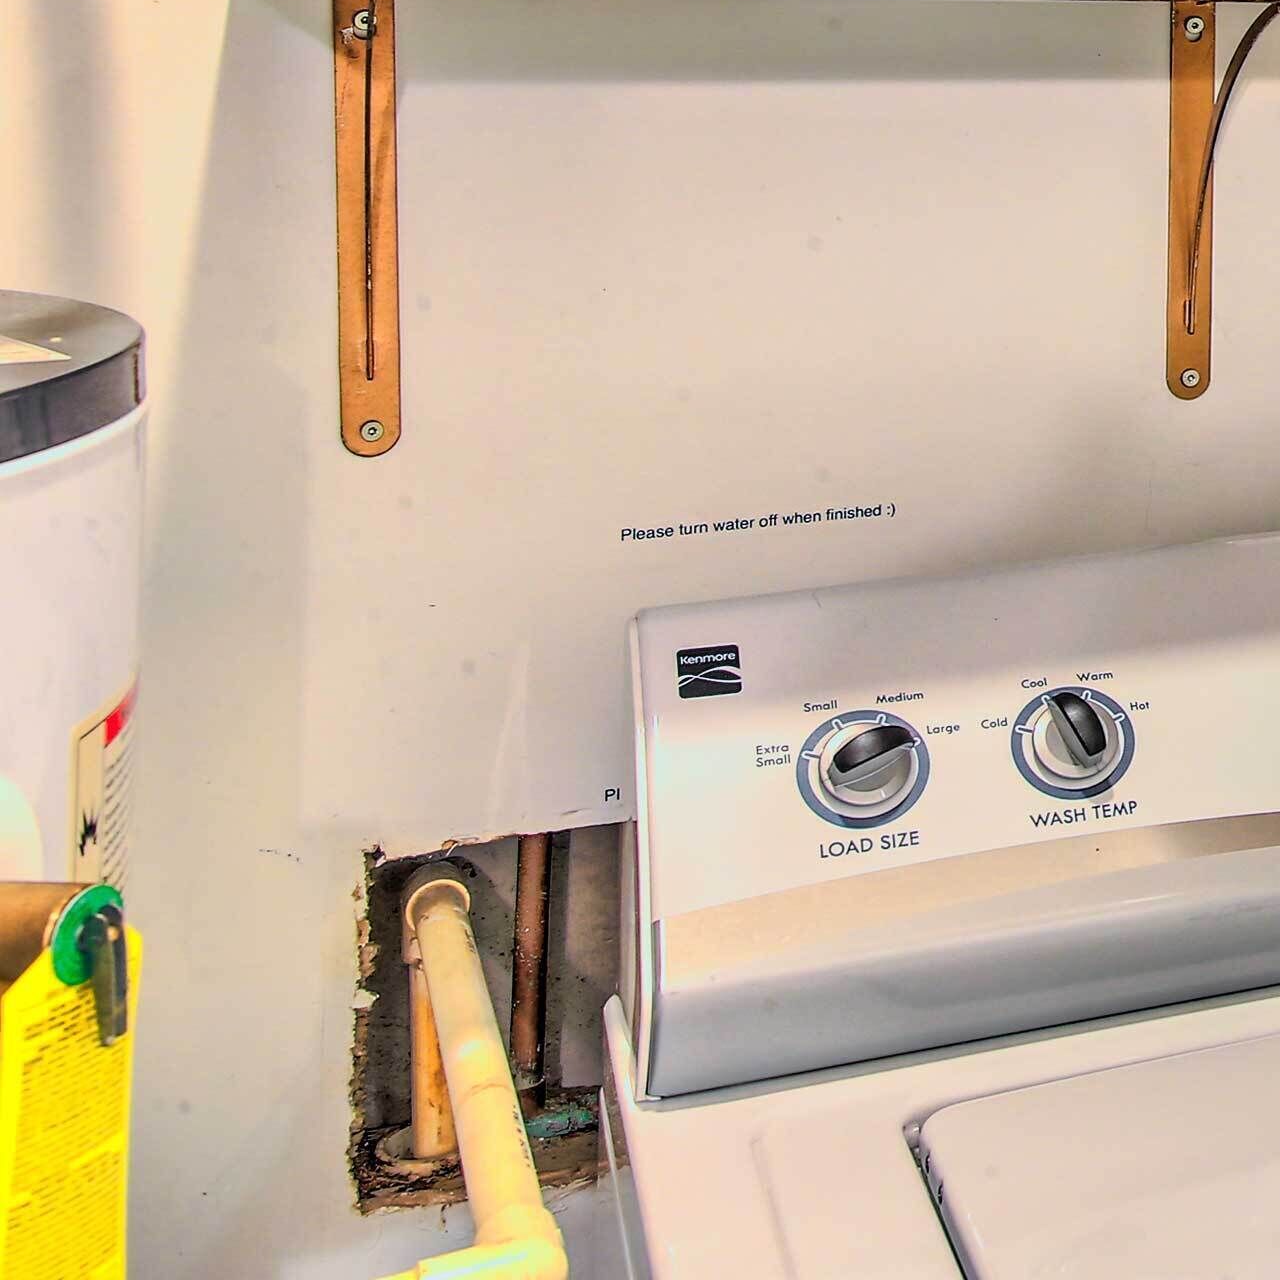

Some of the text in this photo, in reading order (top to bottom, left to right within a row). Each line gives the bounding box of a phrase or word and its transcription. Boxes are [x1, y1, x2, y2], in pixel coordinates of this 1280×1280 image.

[620, 526, 674, 541] Please
[679, 523, 708, 536] turn
[713, 517, 754, 532] water
[759, 513, 778, 528] off
[782, 510, 822, 525] when
[826, 504, 882, 521] finished
[680, 651, 736, 665] Kenmore
[1076, 672, 1114, 681] Warm
[1021, 678, 1048, 689] Cool
[875, 691, 924, 704] Medium
[803, 700, 838, 713] Small
[1130, 701, 1150, 711] Hot
[926, 723, 961, 735] Large
[981, 717, 1008, 729] Cold
[756, 744, 789, 755] Extra
[756, 755, 791, 768] Small
[1029, 800, 1138, 828] WASH TEMP
[819, 830, 921, 860] LOAD SIZE
